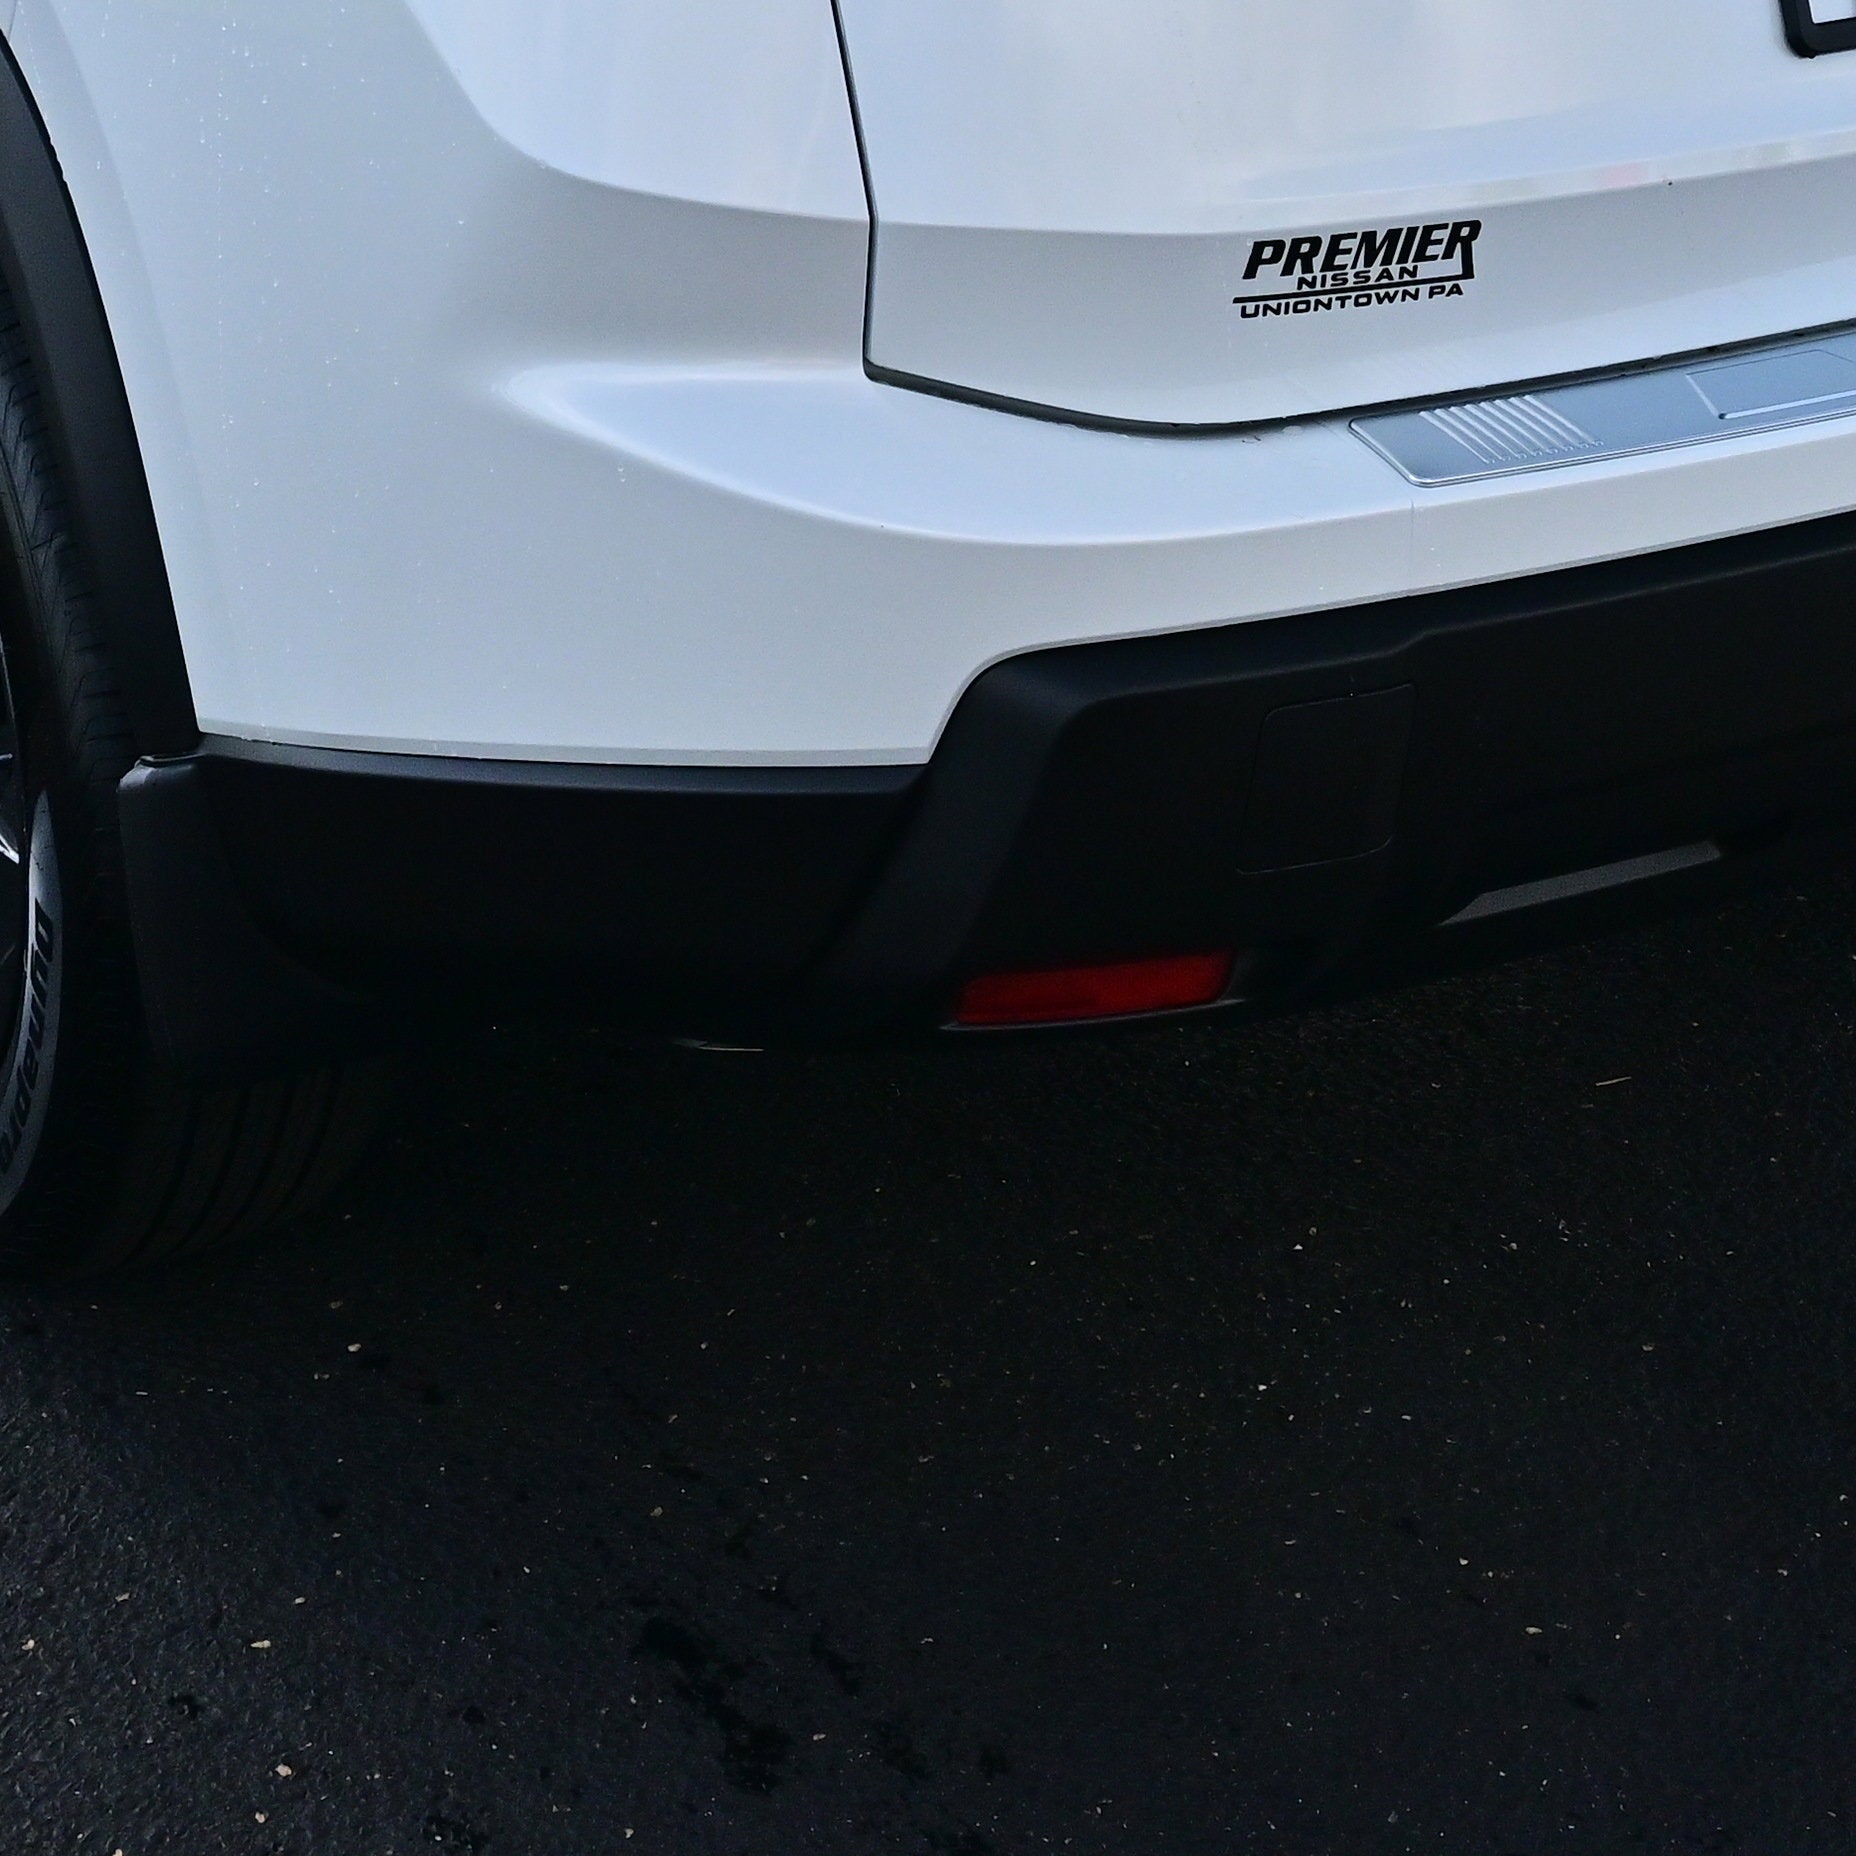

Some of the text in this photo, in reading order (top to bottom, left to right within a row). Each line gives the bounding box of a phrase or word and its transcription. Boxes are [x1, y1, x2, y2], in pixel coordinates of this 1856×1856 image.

[1242, 219, 1482, 280] PREMIER
[1296, 264, 1419, 291] NISSAN
[1240, 282, 1465, 319] UNIONTOWN PA
